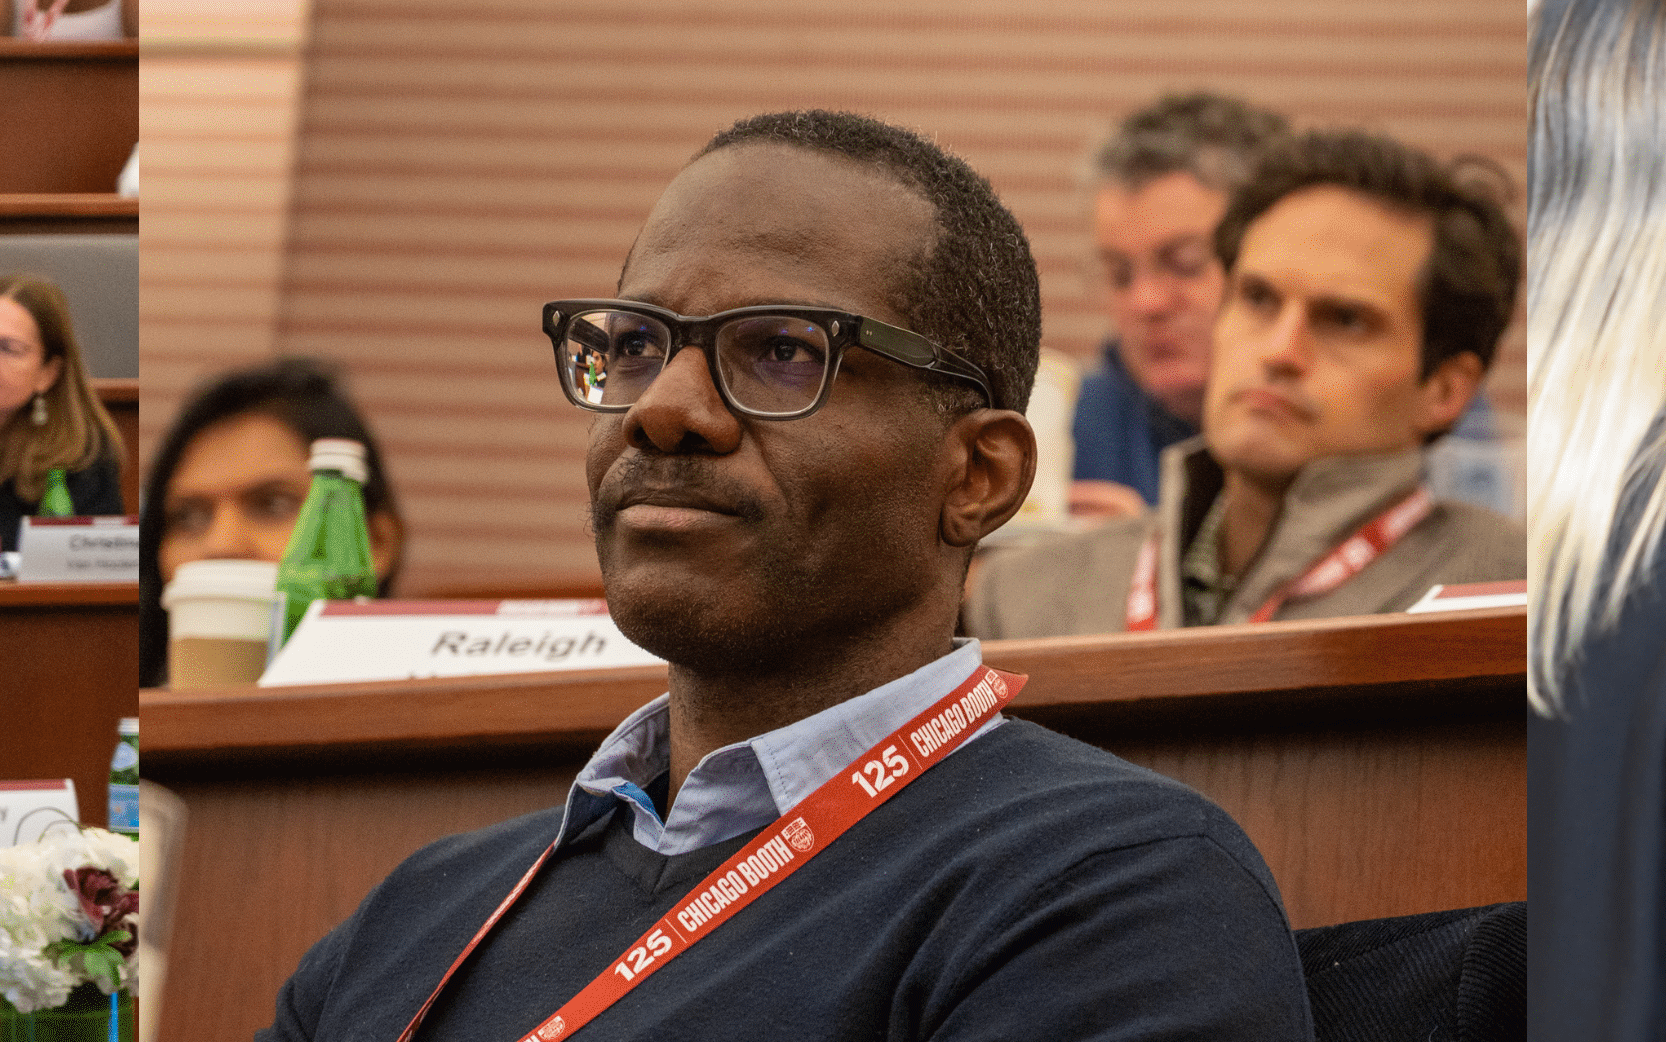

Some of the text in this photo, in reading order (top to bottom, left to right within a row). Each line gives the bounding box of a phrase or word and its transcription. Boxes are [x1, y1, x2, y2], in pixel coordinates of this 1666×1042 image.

[431, 629, 607, 662] Raleigh
[852, 679, 997, 798] 125 CHICAGO BOOTH
[614, 835, 795, 981] 125 CHICAGO BOOTH
